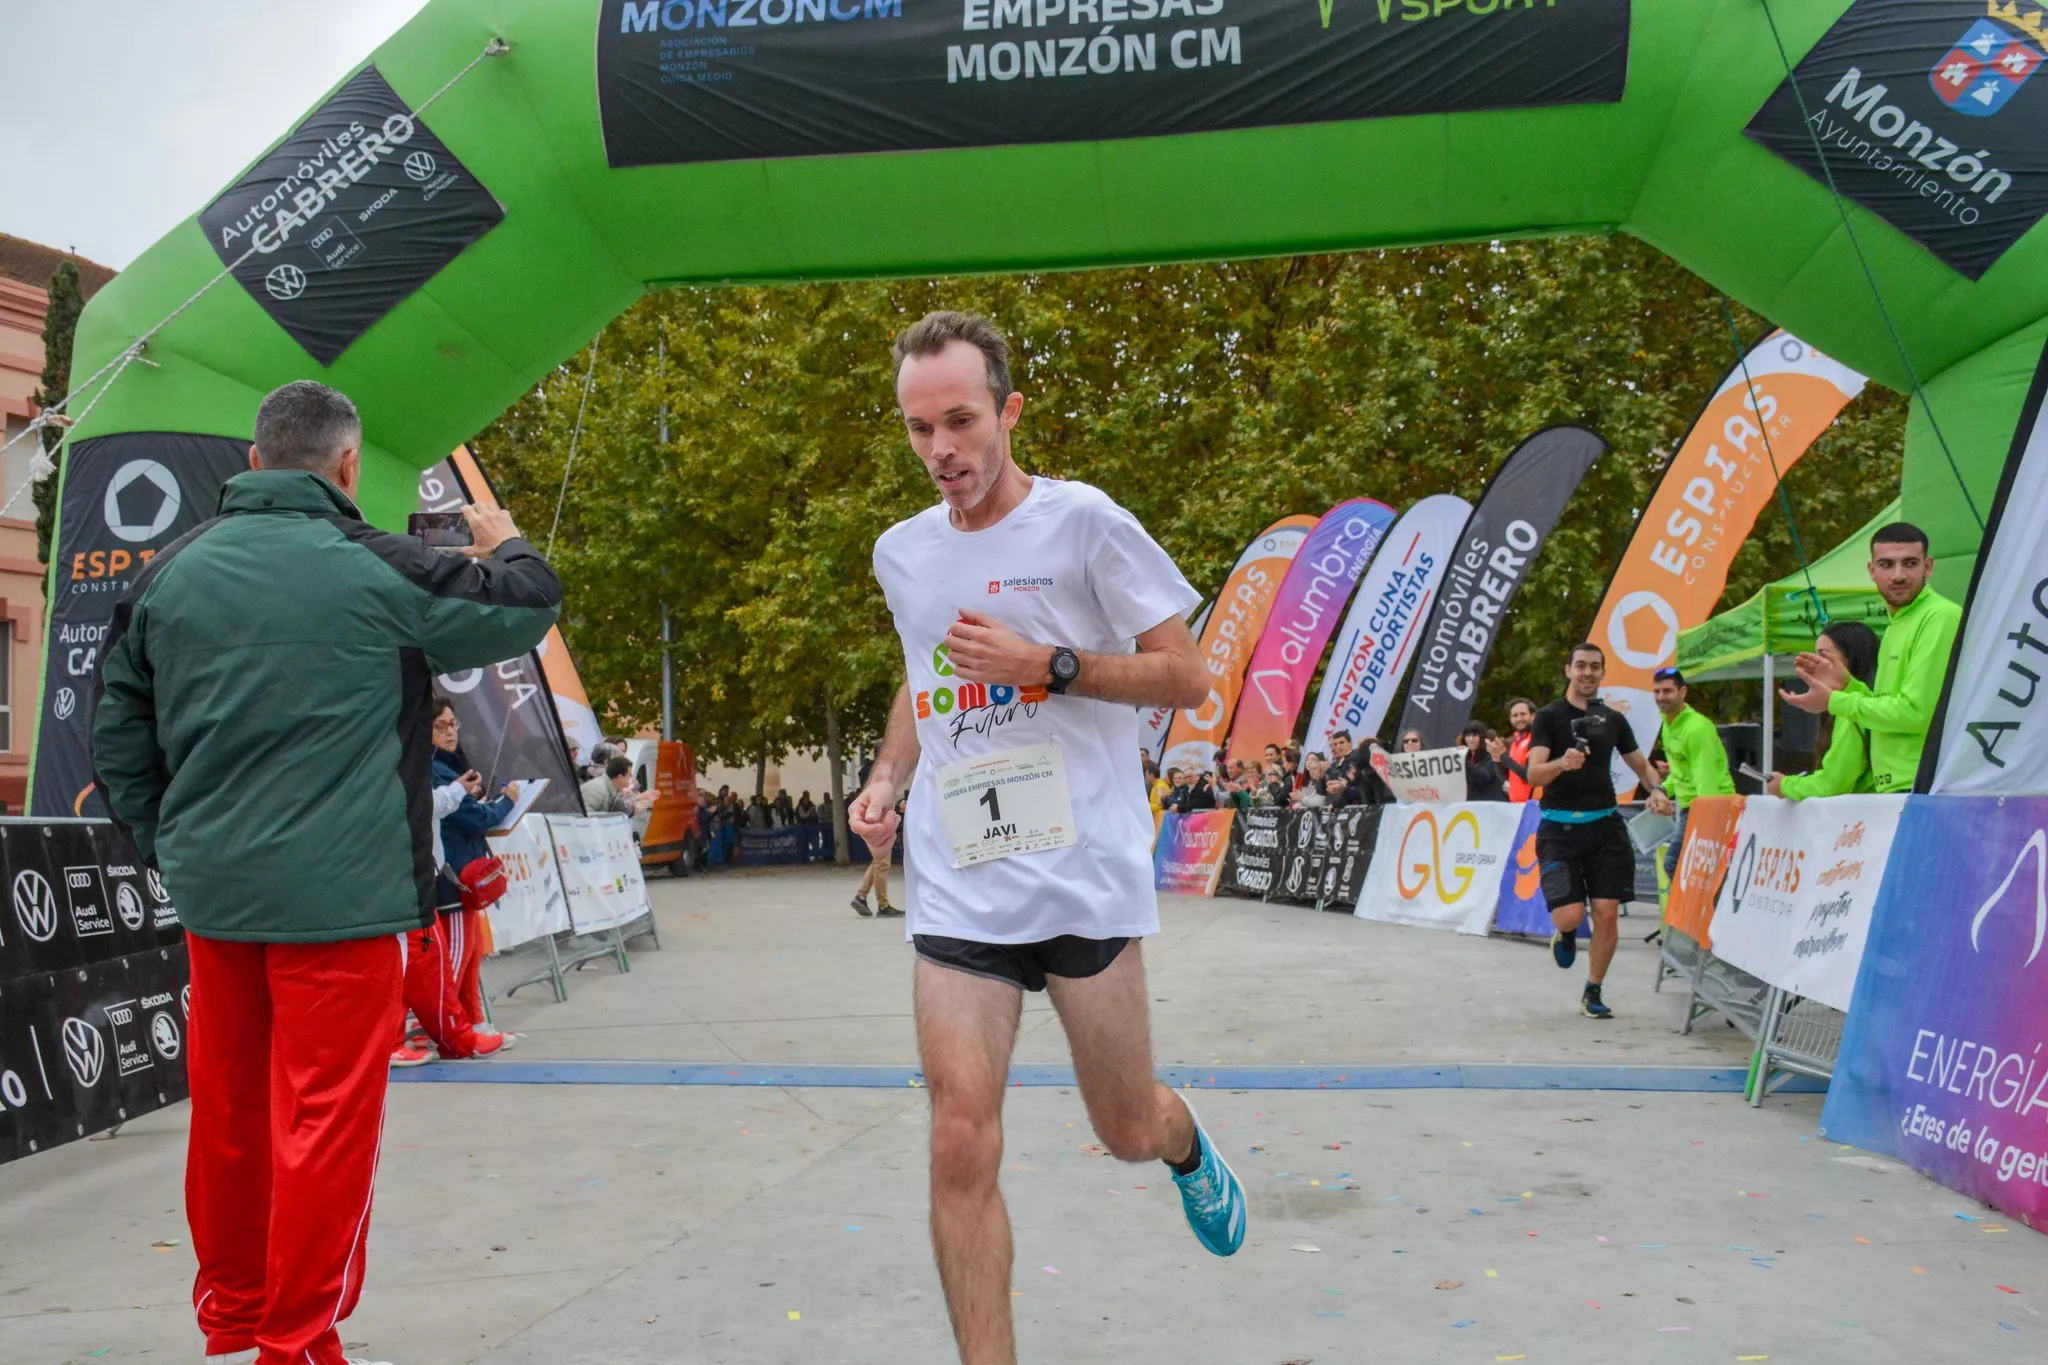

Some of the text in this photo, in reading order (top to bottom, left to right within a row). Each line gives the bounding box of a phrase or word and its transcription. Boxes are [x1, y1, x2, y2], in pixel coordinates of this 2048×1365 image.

[660, 36, 728, 48] ASOCIACIÓN
[660, 46, 756, 60] DE EMPRESARIOS
[947, 25, 1241, 83] MONZÓN CM
[660, 61, 708, 72] MONZÓN
[697, 71, 733, 82] MEDIO
[1824, 66, 2012, 204] Monzón
[221, 120, 365, 248] Automóviles
[251, 113, 414, 254] CABRERO
[1806, 108, 1980, 225] Ayuntamiento
[325, 243, 346, 262] Audi
[1650, 384, 1778, 576] ESPIAS
[1348, 527, 1383, 583] ENERGÍA
[1003, 576, 1054, 588] salesianos
[1013, 584, 1040, 592] MONZÓN
[1280, 516, 1370, 665] alumbra
[1369, 570, 1408, 633] CUNA
[1207, 566, 1268, 677] ESPIAS
[1411, 537, 1489, 713] Automóviles
[1446, 519, 1538, 701] CABRERO
[1344, 552, 1434, 728] DE DEPORTISTAS
[944, 788, 968, 800] CARRERA
[968, 779, 1006, 793] EMPRESAS
[1007, 772, 1040, 784] MONZÓN
[1041, 770, 1053, 779] CM
[980, 787, 1002, 821] 1
[983, 823, 1017, 839] JAVI
[75, 905, 97, 917] Audi
[78, 917, 110, 931] Service
[120, 1040, 137, 1055] Audi
[121, 1053, 149, 1070] Service
[1901, 1104, 1946, 1144] ¿Eres
[1946, 1118, 1971, 1153] de
[1974, 1126, 1999, 1164] la
